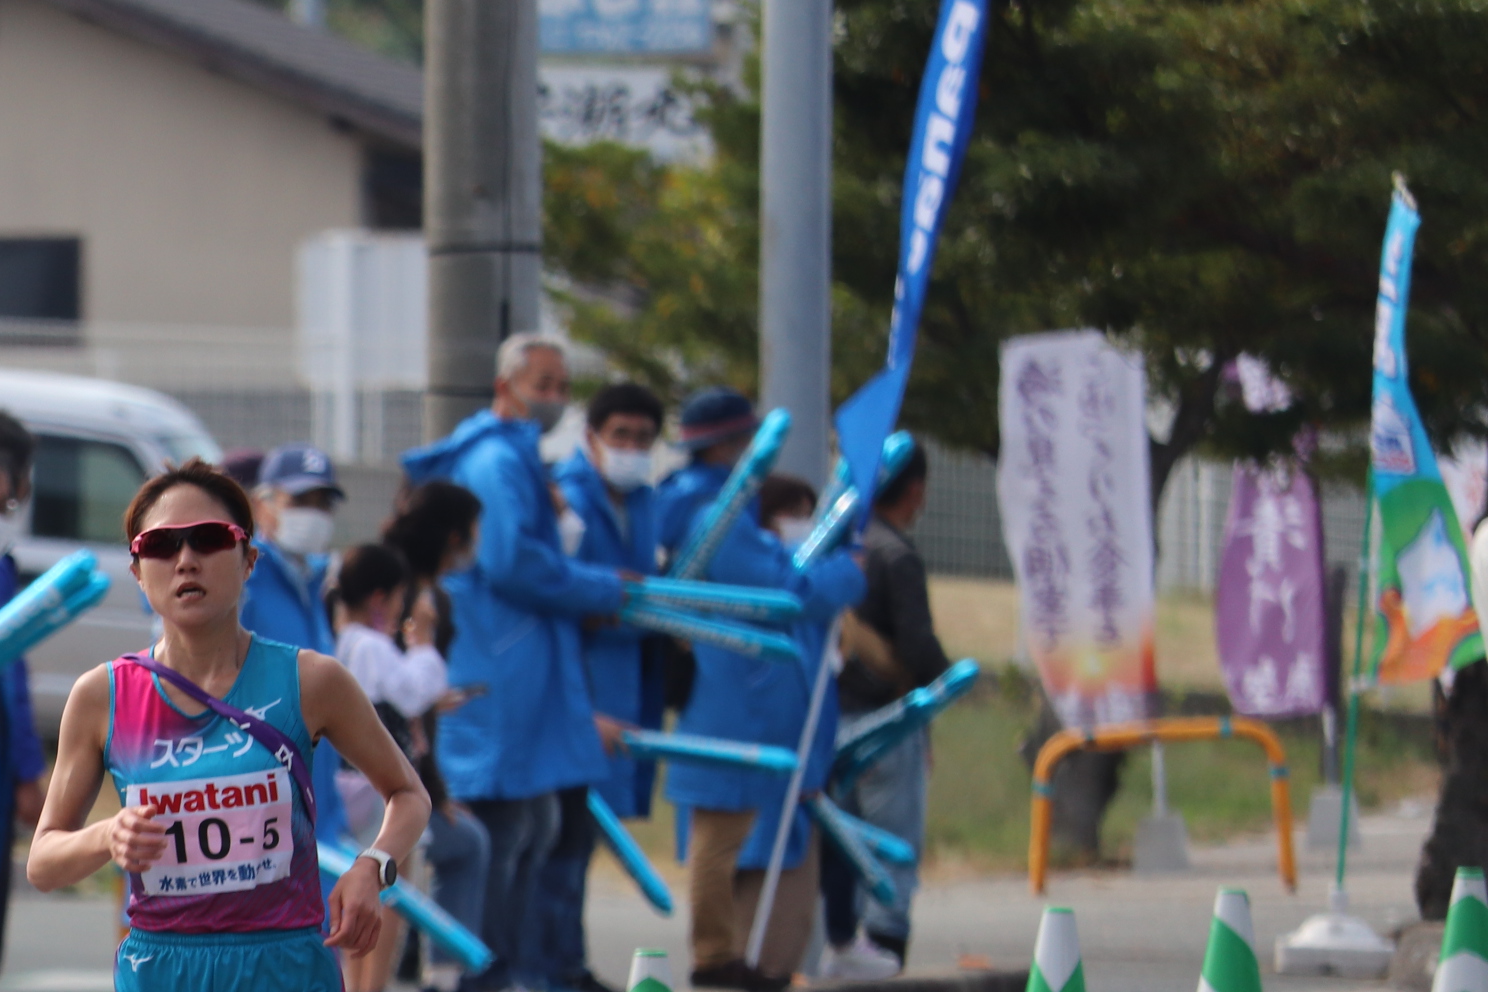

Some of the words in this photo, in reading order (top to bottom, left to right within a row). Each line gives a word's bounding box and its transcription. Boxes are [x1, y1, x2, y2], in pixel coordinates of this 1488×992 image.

[150, 731, 254, 769] スターツ
[139, 773, 279, 815] Iwatani
